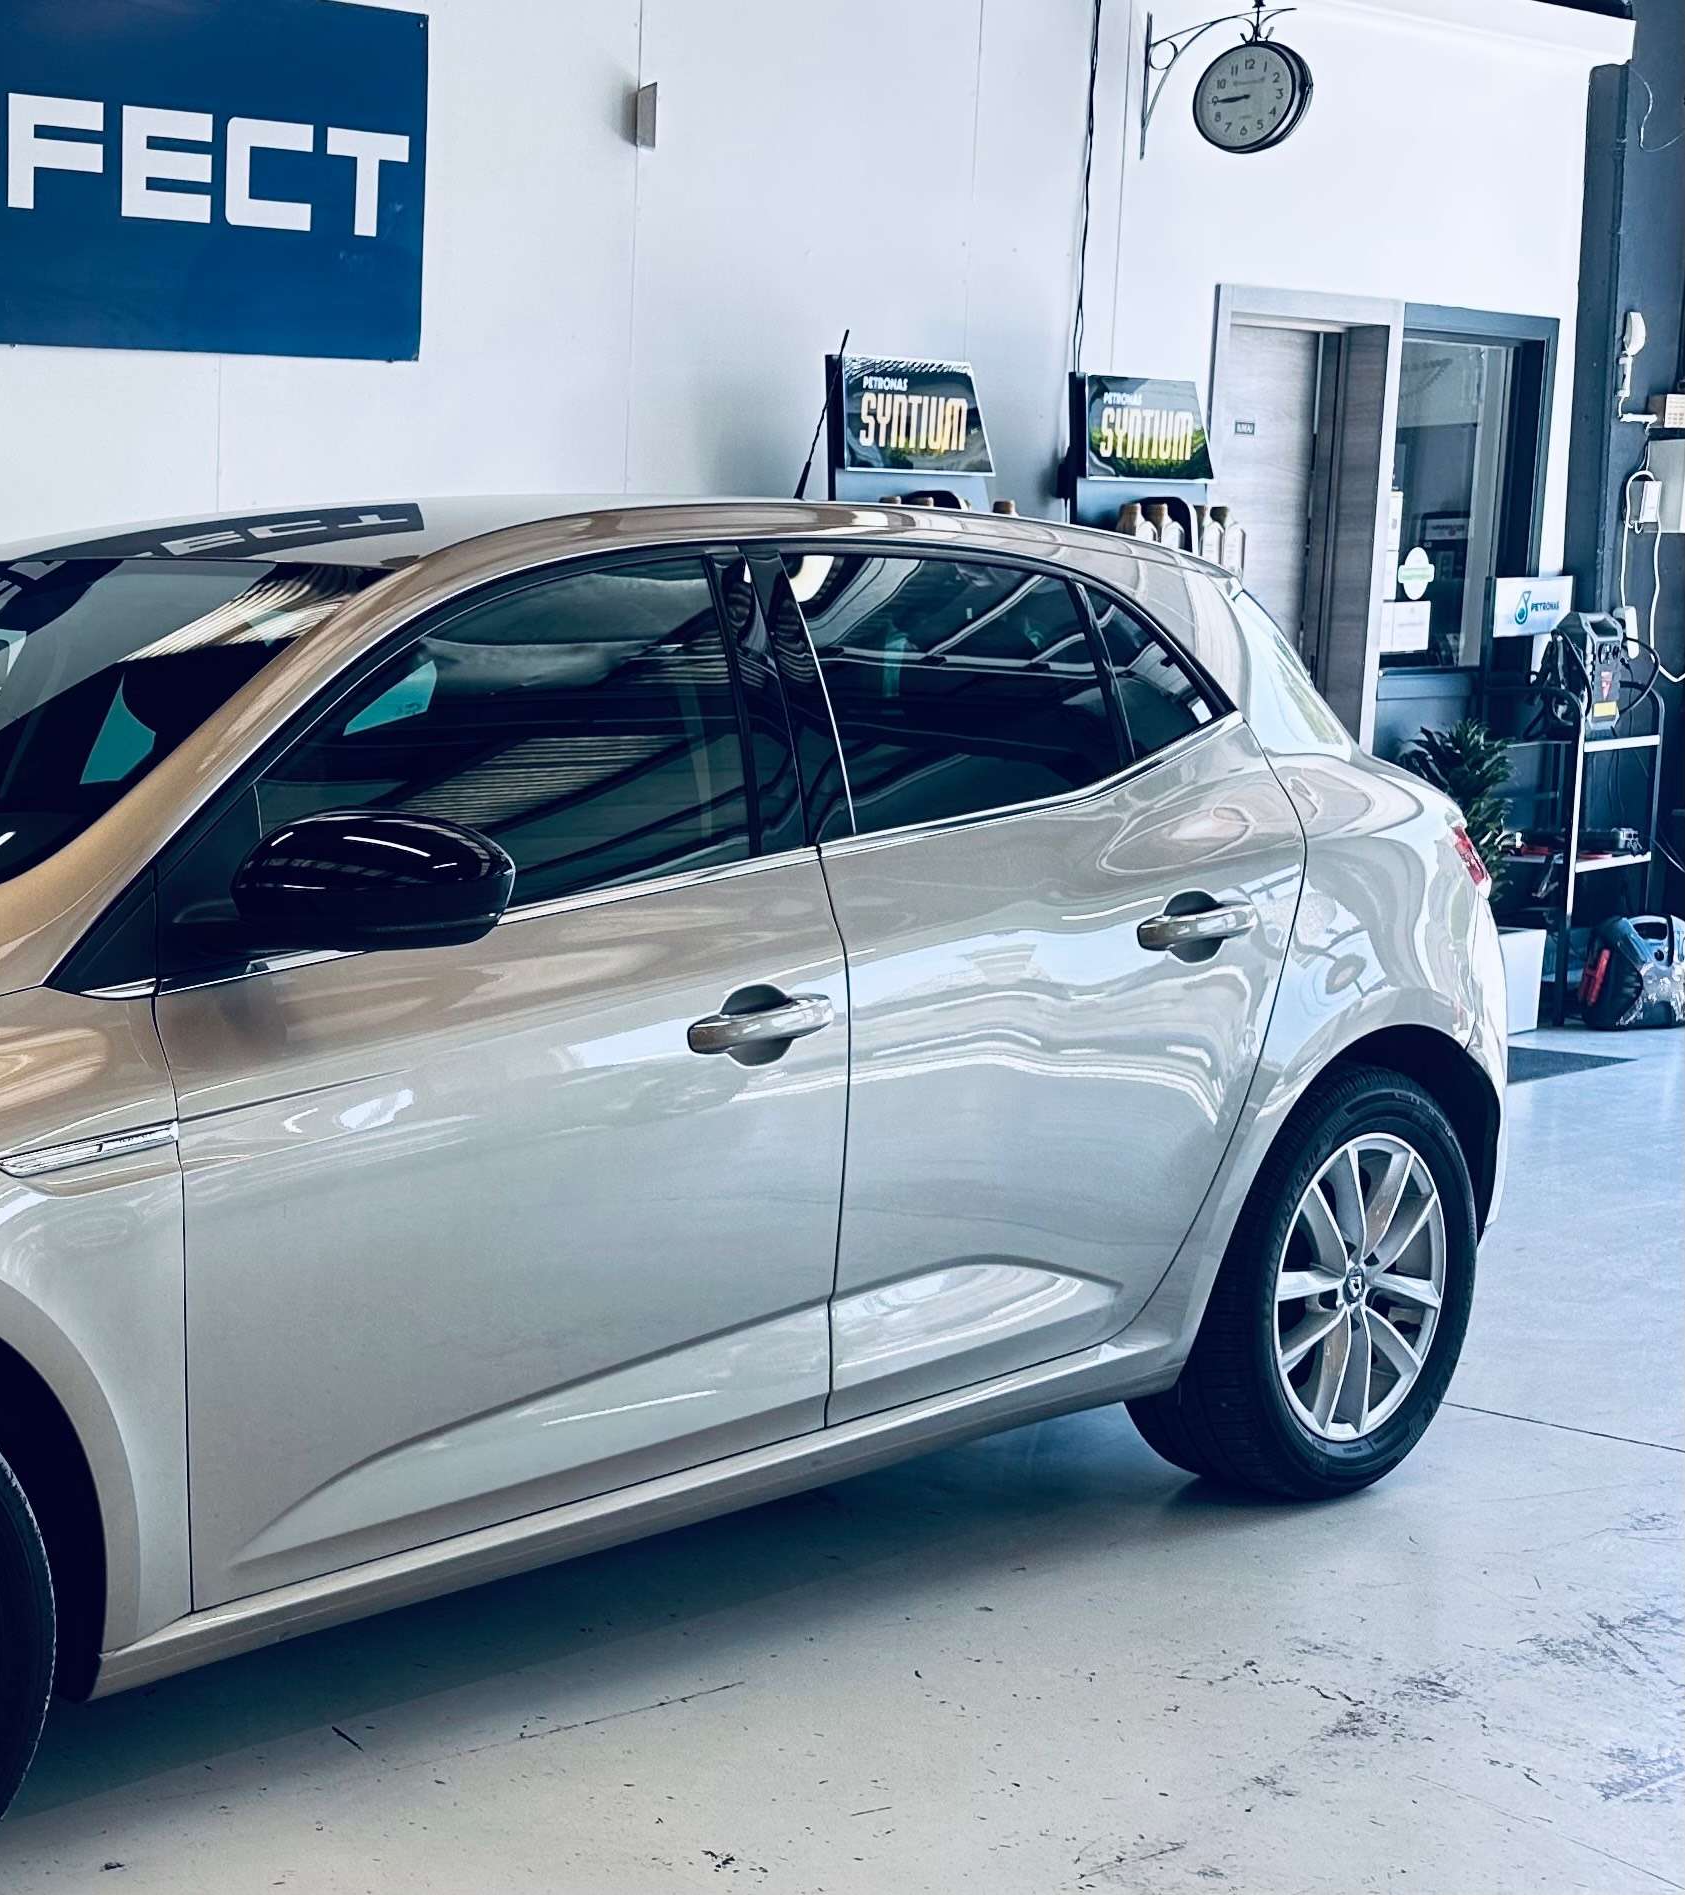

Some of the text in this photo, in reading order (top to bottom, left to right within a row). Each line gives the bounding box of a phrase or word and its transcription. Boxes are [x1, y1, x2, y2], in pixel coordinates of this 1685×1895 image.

[1230, 63, 1239, 76] 11
[1244, 58, 1256, 70] 12
[1272, 72, 1281, 83] 2
[1216, 79, 1227, 89] 10
[1275, 88, 1285, 100] 3
[1214, 112, 1222, 122] 8
[1268, 105, 1277, 118] 4
[1224, 122, 1233, 133] 7
[1239, 126, 1248, 136] 6
[1256, 120, 1264, 130] 5
[862, 376, 909, 392] PETRONAS
[859, 391, 968, 452] SYNTIUM
[1099, 406, 1194, 461] SYNTIUM
